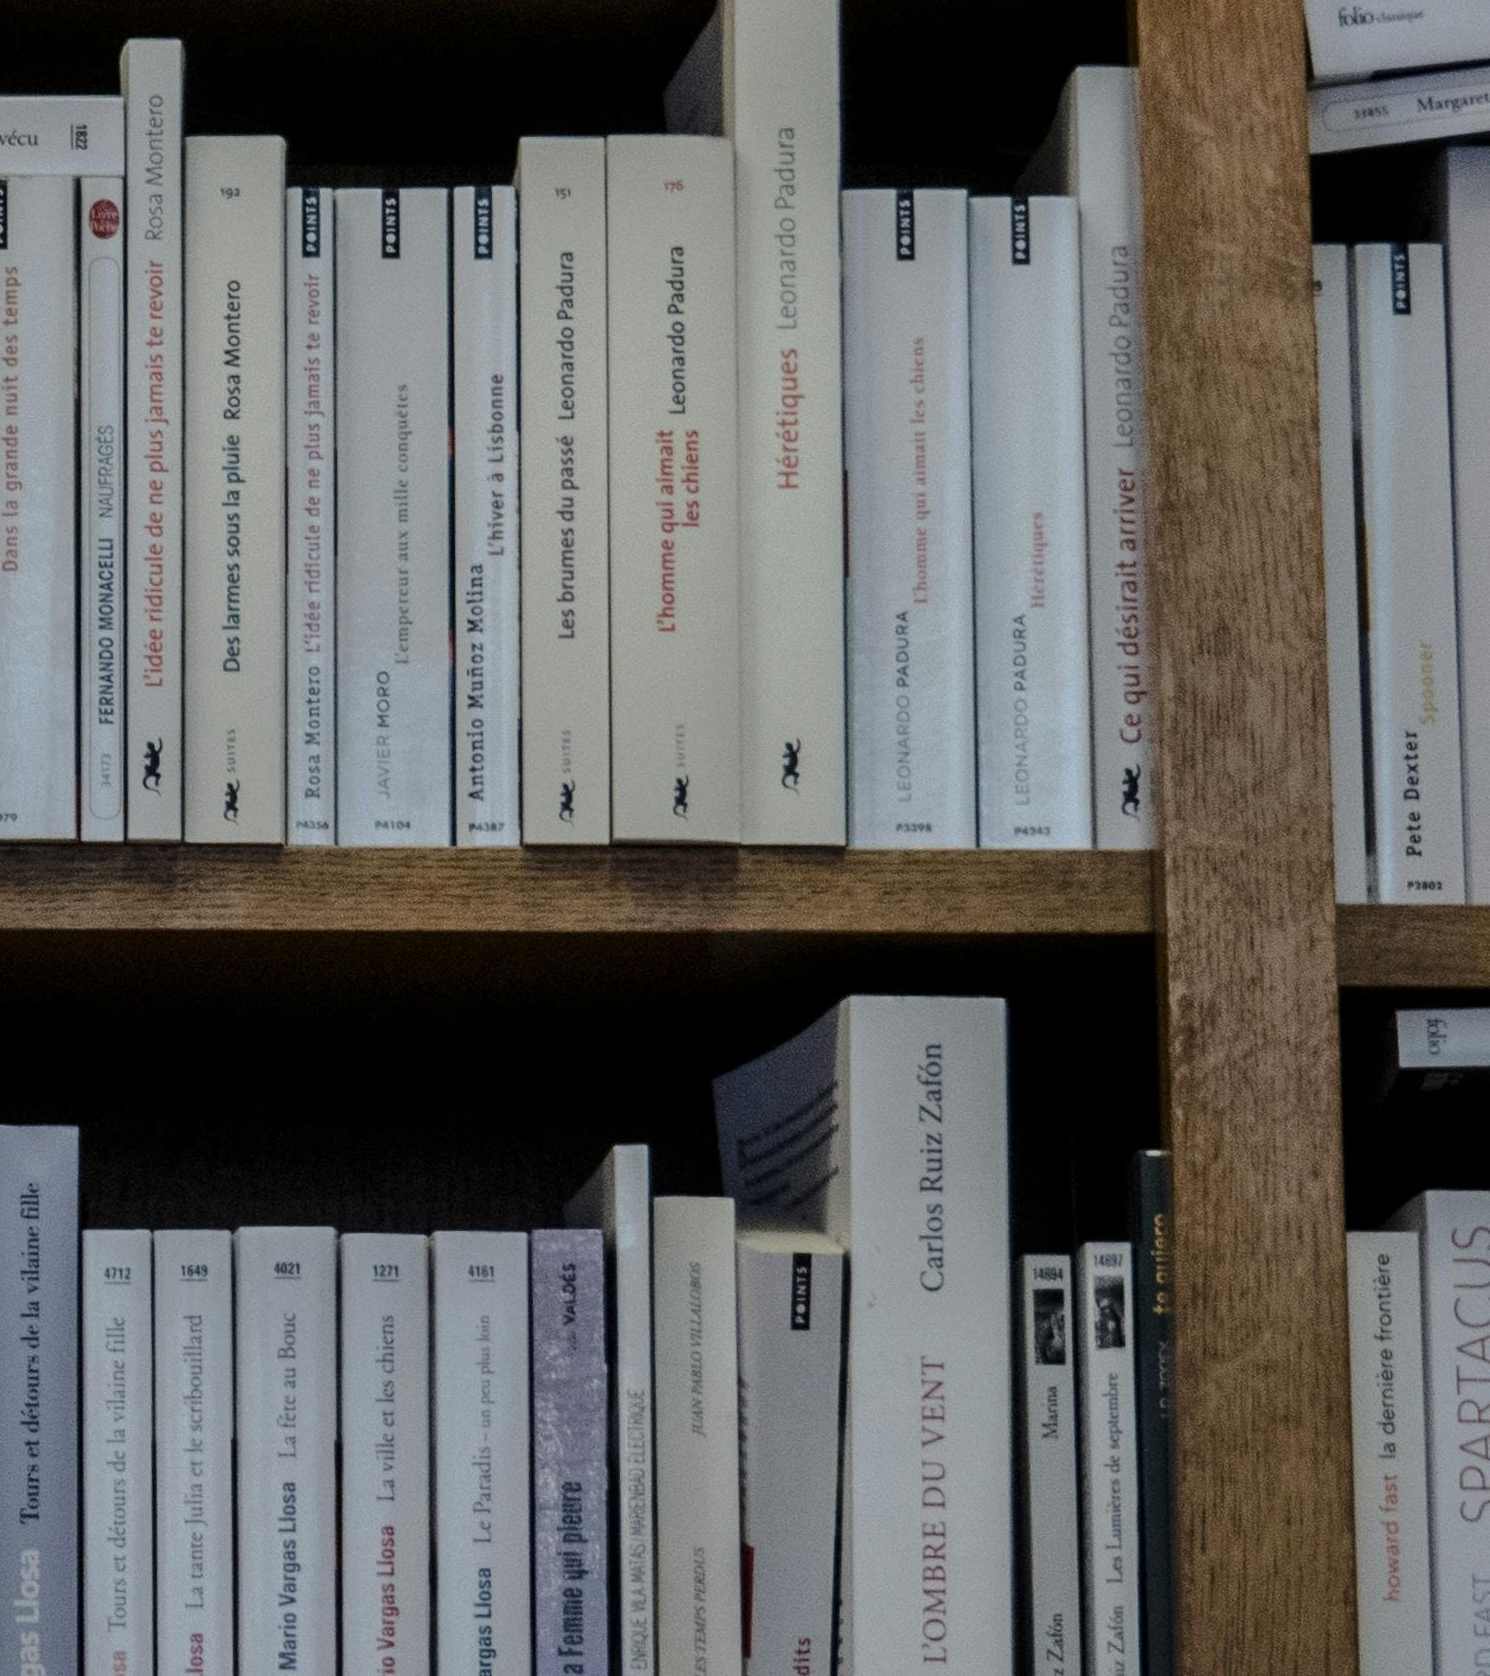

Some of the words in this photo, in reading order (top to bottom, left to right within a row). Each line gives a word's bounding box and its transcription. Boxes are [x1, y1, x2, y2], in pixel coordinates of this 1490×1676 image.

[772, 125, 797, 211] Padura
[773, 216, 799, 331] Leonardo
[222, 278, 242, 369] Montero
[221, 372, 242, 421] Rosa
[774, 346, 806, 490] Hérétiques
[220, 432, 247, 485] pluie
[220, 488, 241, 508] la
[225, 511, 242, 559] sous
[220, 561, 242, 631] larmes
[221, 634, 242, 673] Des
[1401, 729, 1421, 802] Dexter
[1404, 810, 1424, 858] Pete
[915, 1042, 944, 1125] Zafón
[917, 1131, 945, 1194] Ruiz
[917, 1202, 945, 1293] Carlos
[1371, 1252, 1394, 1343] frontière
[919, 1354, 946, 1449] VENT
[1374, 1346, 1397, 1437] dernière
[920, 1458, 947, 1510] DU
[1376, 1440, 1398, 1460] la
[276, 1480, 298, 1534] Llosa
[1377, 1473, 1399, 1514] fast
[277, 1537, 302, 1608] Vargas
[920, 1520, 948, 1665] L'OMBRE
[1380, 1520, 1401, 1603] howard
[276, 1611, 298, 1671] Mario
